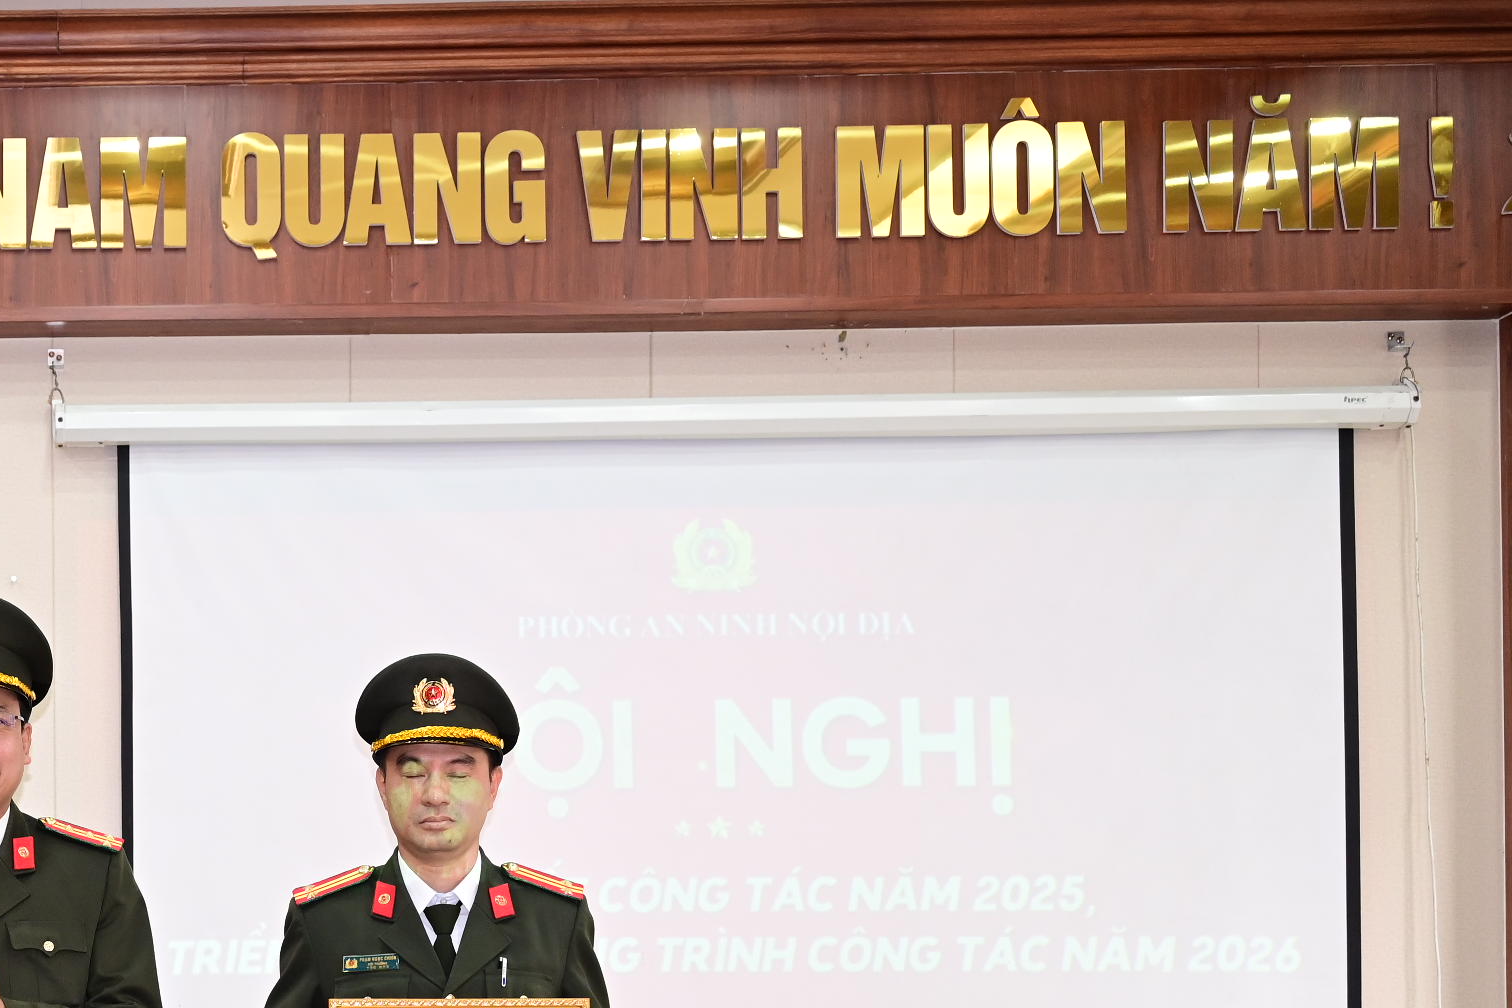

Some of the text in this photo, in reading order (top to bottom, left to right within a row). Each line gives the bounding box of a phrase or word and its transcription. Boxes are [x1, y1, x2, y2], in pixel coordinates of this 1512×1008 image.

[221, 129, 546, 260] QUANG
[576, 127, 804, 242] VINH
[835, 97, 1127, 239] MUÔN
[1162, 93, 1400, 235] NĂM
[517, 608, 632, 640] PHÒNG
[643, 613, 687, 639] AN
[696, 612, 777, 638] NINH
[788, 608, 846, 642] NỘI
[516, 666, 1015, 818] ỘI NGHỊ
[599, 865, 1097, 919] CÔNG TÁC NĂM 2025,
[657, 927, 797, 973] TRÌNH
[806, 928, 946, 973] CÔNG
[955, 928, 1050, 973] TÁC
[1060, 927, 1177, 973] NĂM
[1187, 934, 1304, 974] 2026
